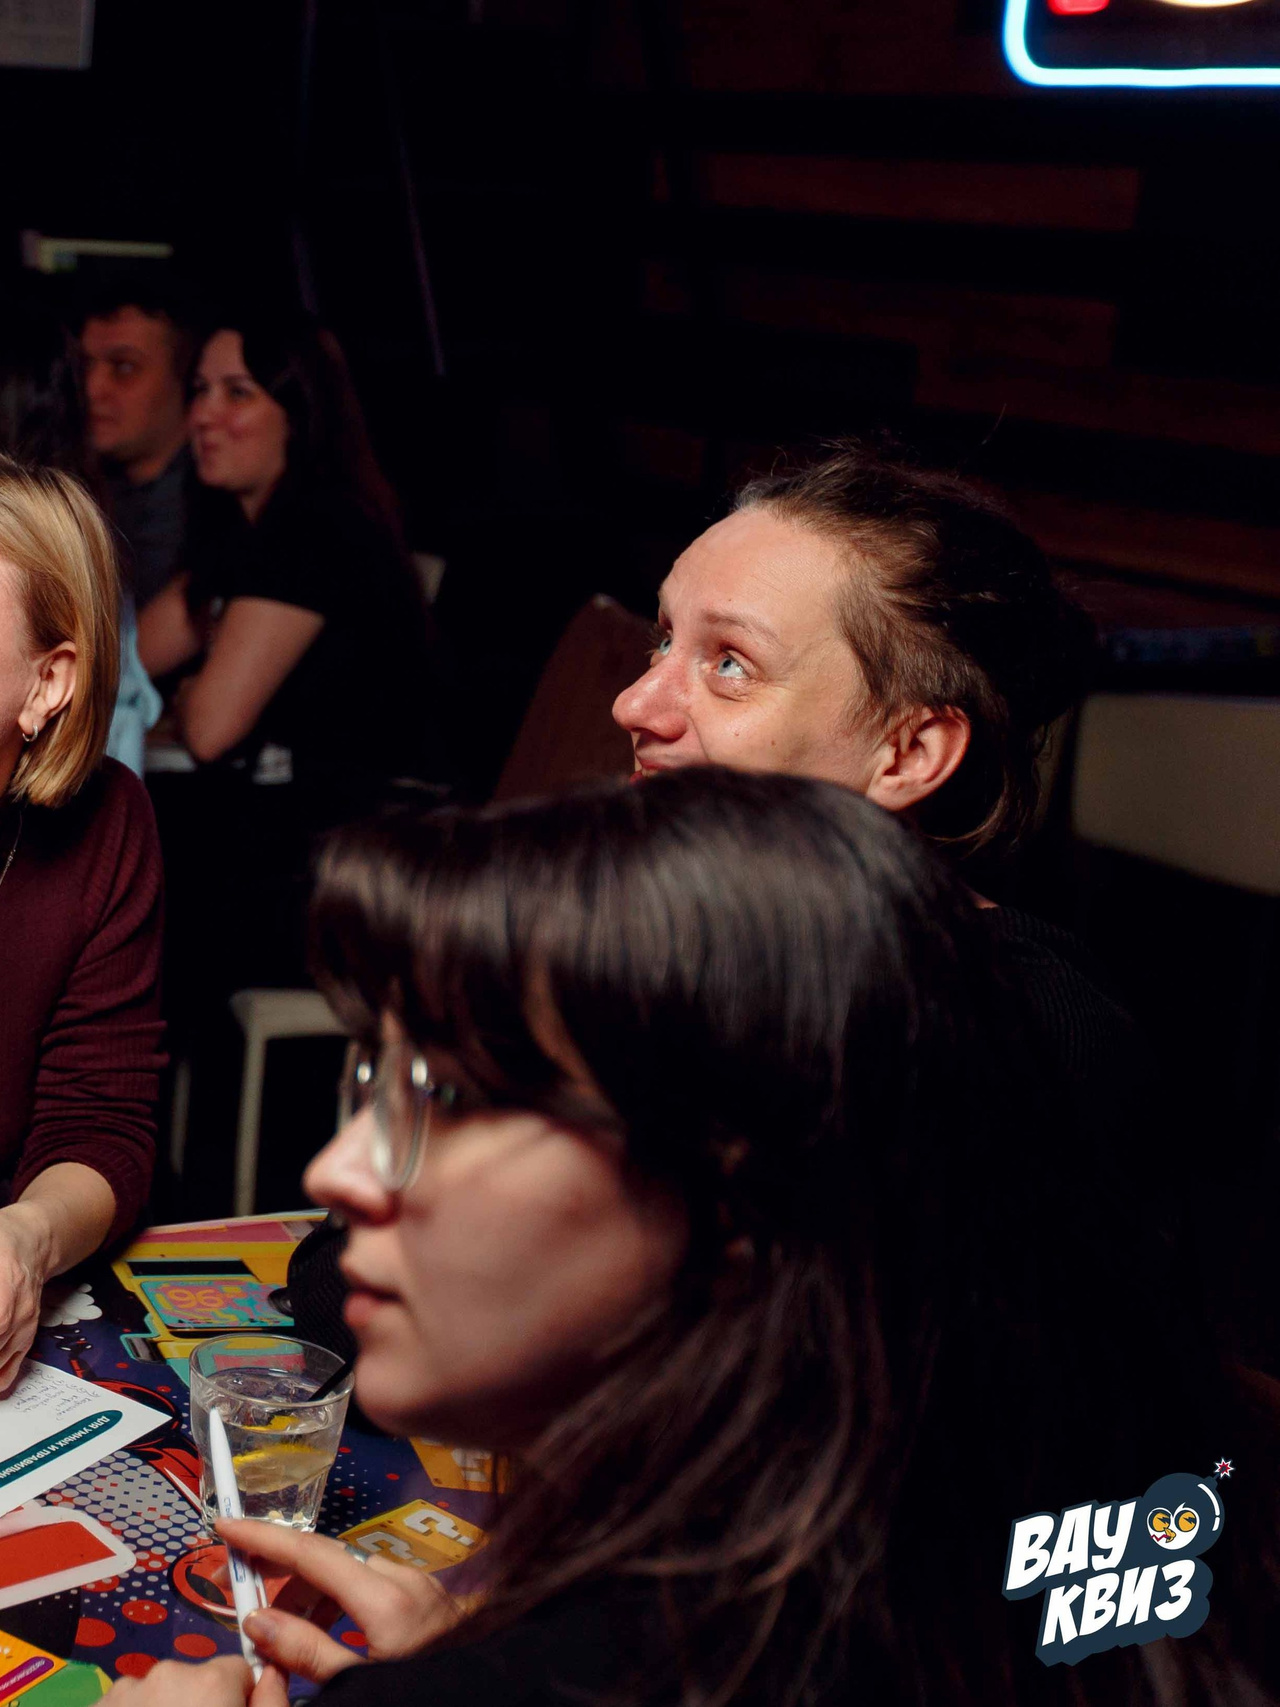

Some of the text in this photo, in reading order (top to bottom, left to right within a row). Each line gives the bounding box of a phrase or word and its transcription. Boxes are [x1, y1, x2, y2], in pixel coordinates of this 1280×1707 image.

[88, 1415, 111, 1429] ДЛЯ
[55, 1427, 93, 1448] УМНЫХ
[48, 1444, 59, 1452] И
